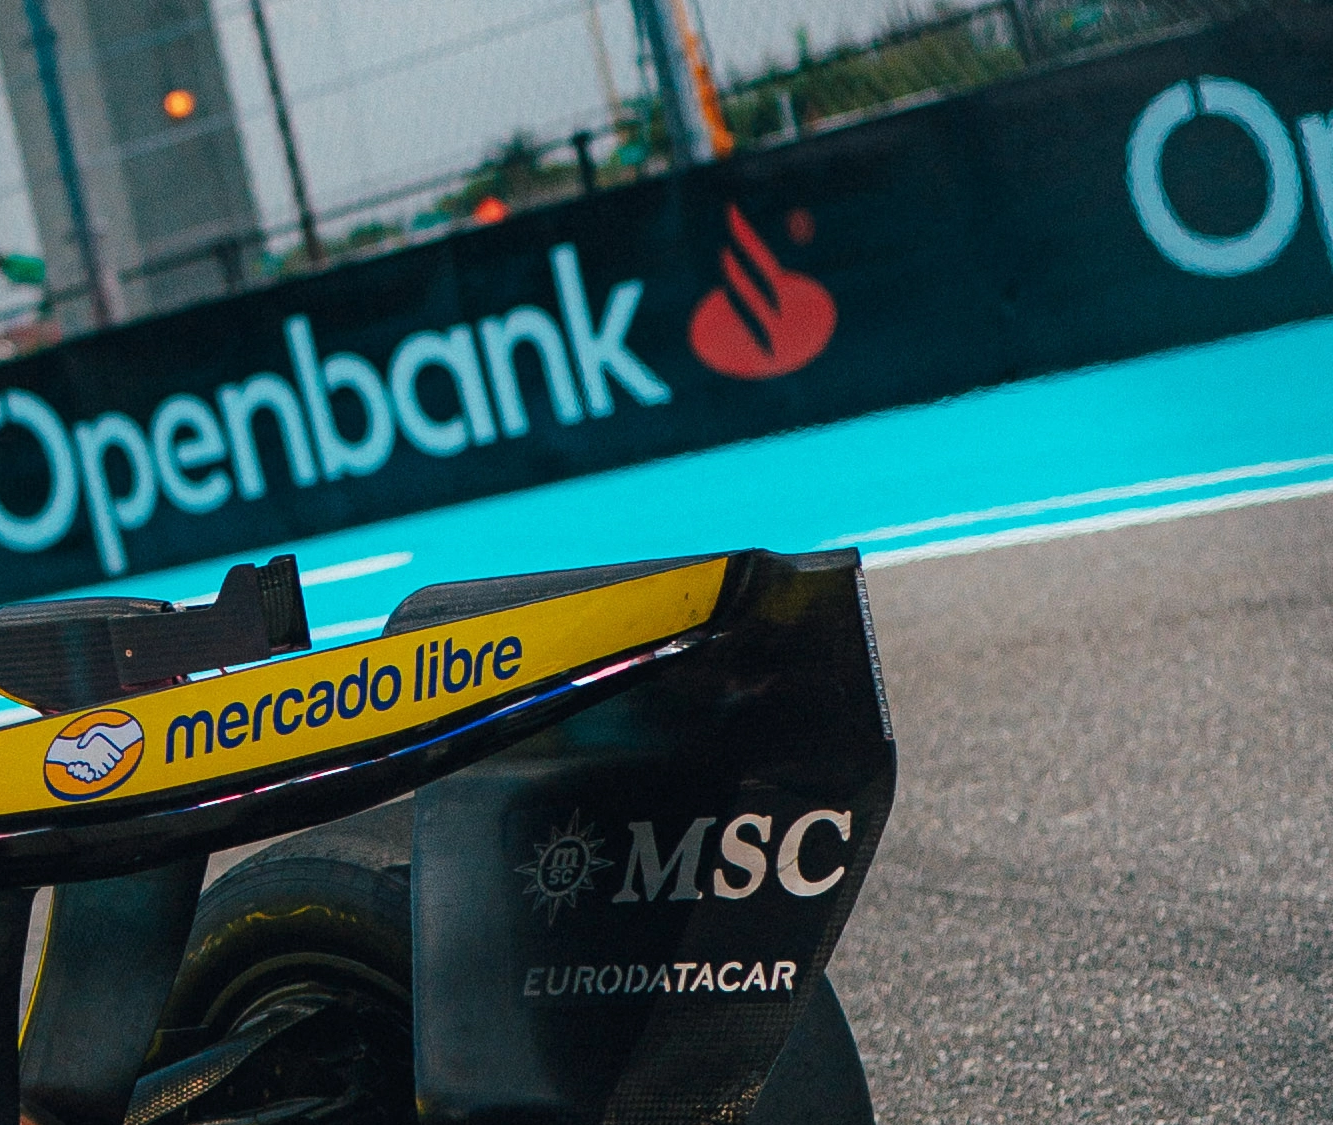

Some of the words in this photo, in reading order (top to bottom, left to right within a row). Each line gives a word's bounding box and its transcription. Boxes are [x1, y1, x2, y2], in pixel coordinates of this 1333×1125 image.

[165, 657, 402, 764] mercado
[414, 635, 523, 702] libre
[613, 809, 851, 903] MSC
[523, 961, 796, 996] EURODATACAR
